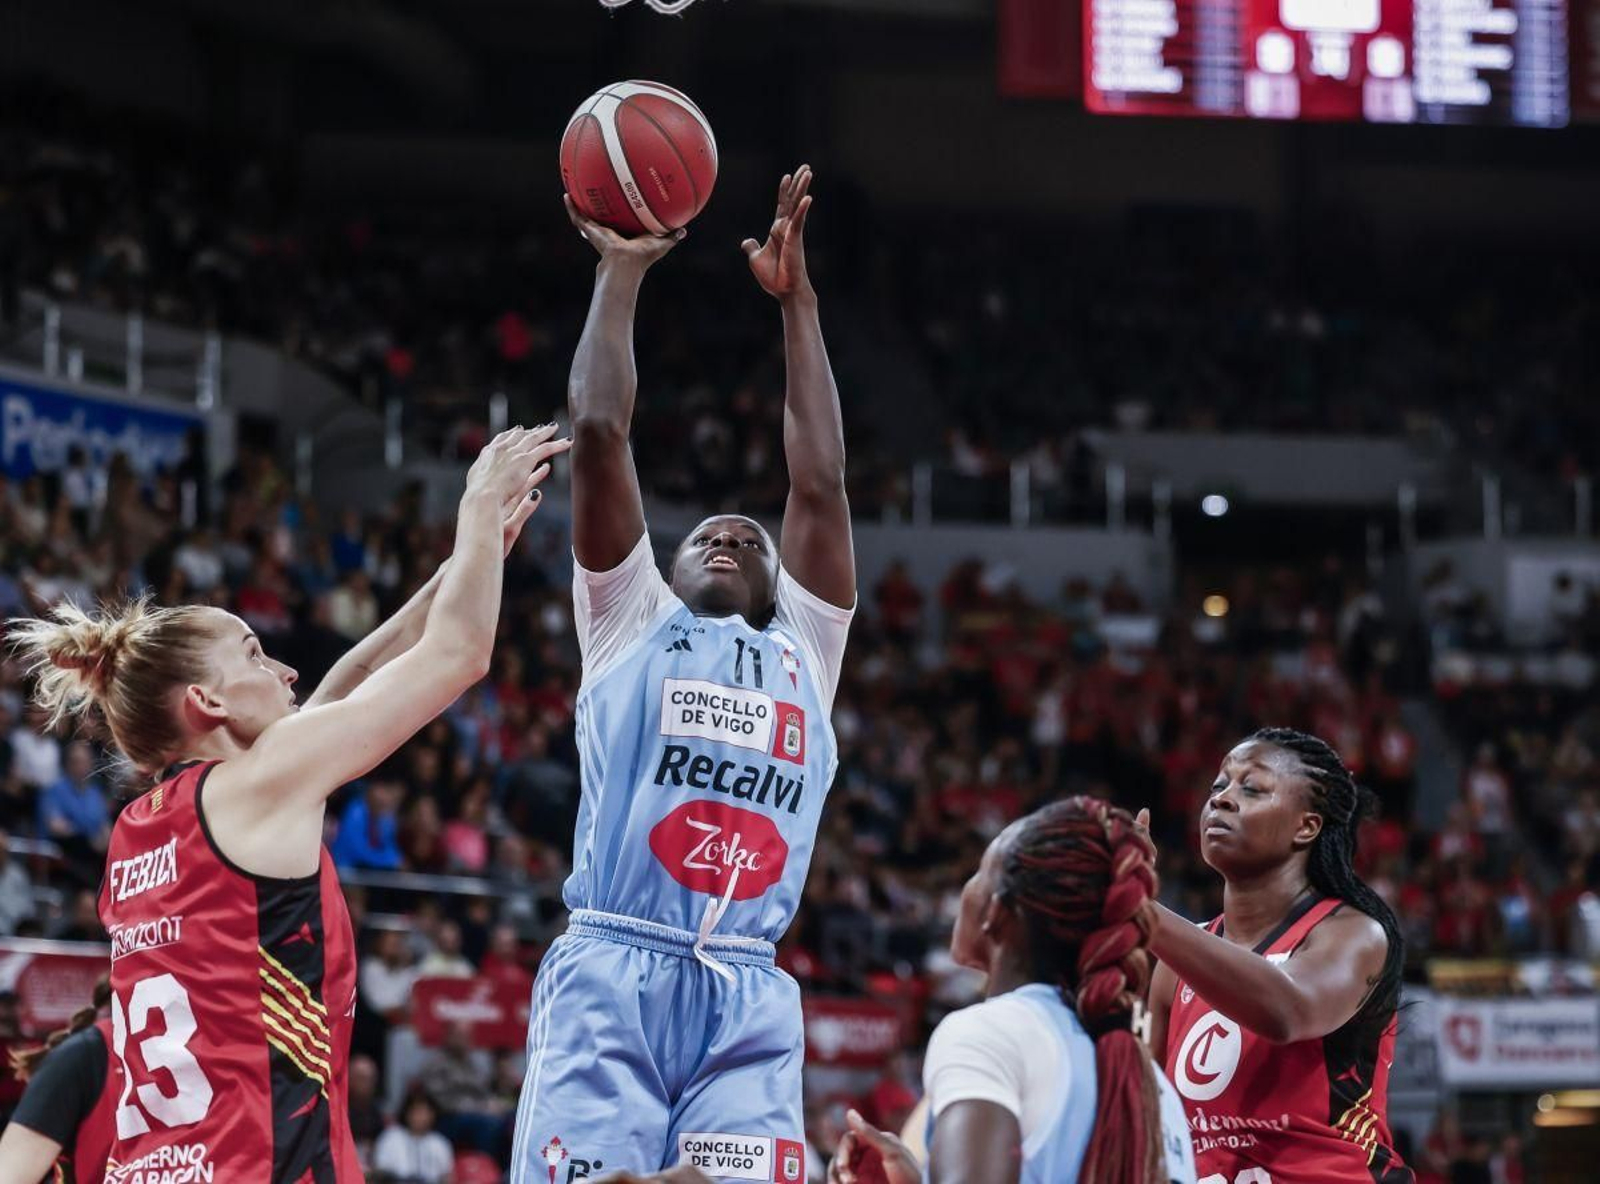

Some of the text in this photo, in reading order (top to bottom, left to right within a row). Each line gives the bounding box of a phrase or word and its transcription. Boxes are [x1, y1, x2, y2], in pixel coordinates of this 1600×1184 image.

[734, 637, 763, 689] 11
[671, 691, 767, 719] CONCELLO
[681, 709, 755, 735] DE VIGO
[653, 744, 804, 814] Recalvi
[684, 1140, 765, 1157] CONCELLO
[691, 1155, 754, 1170] DE VIGO
